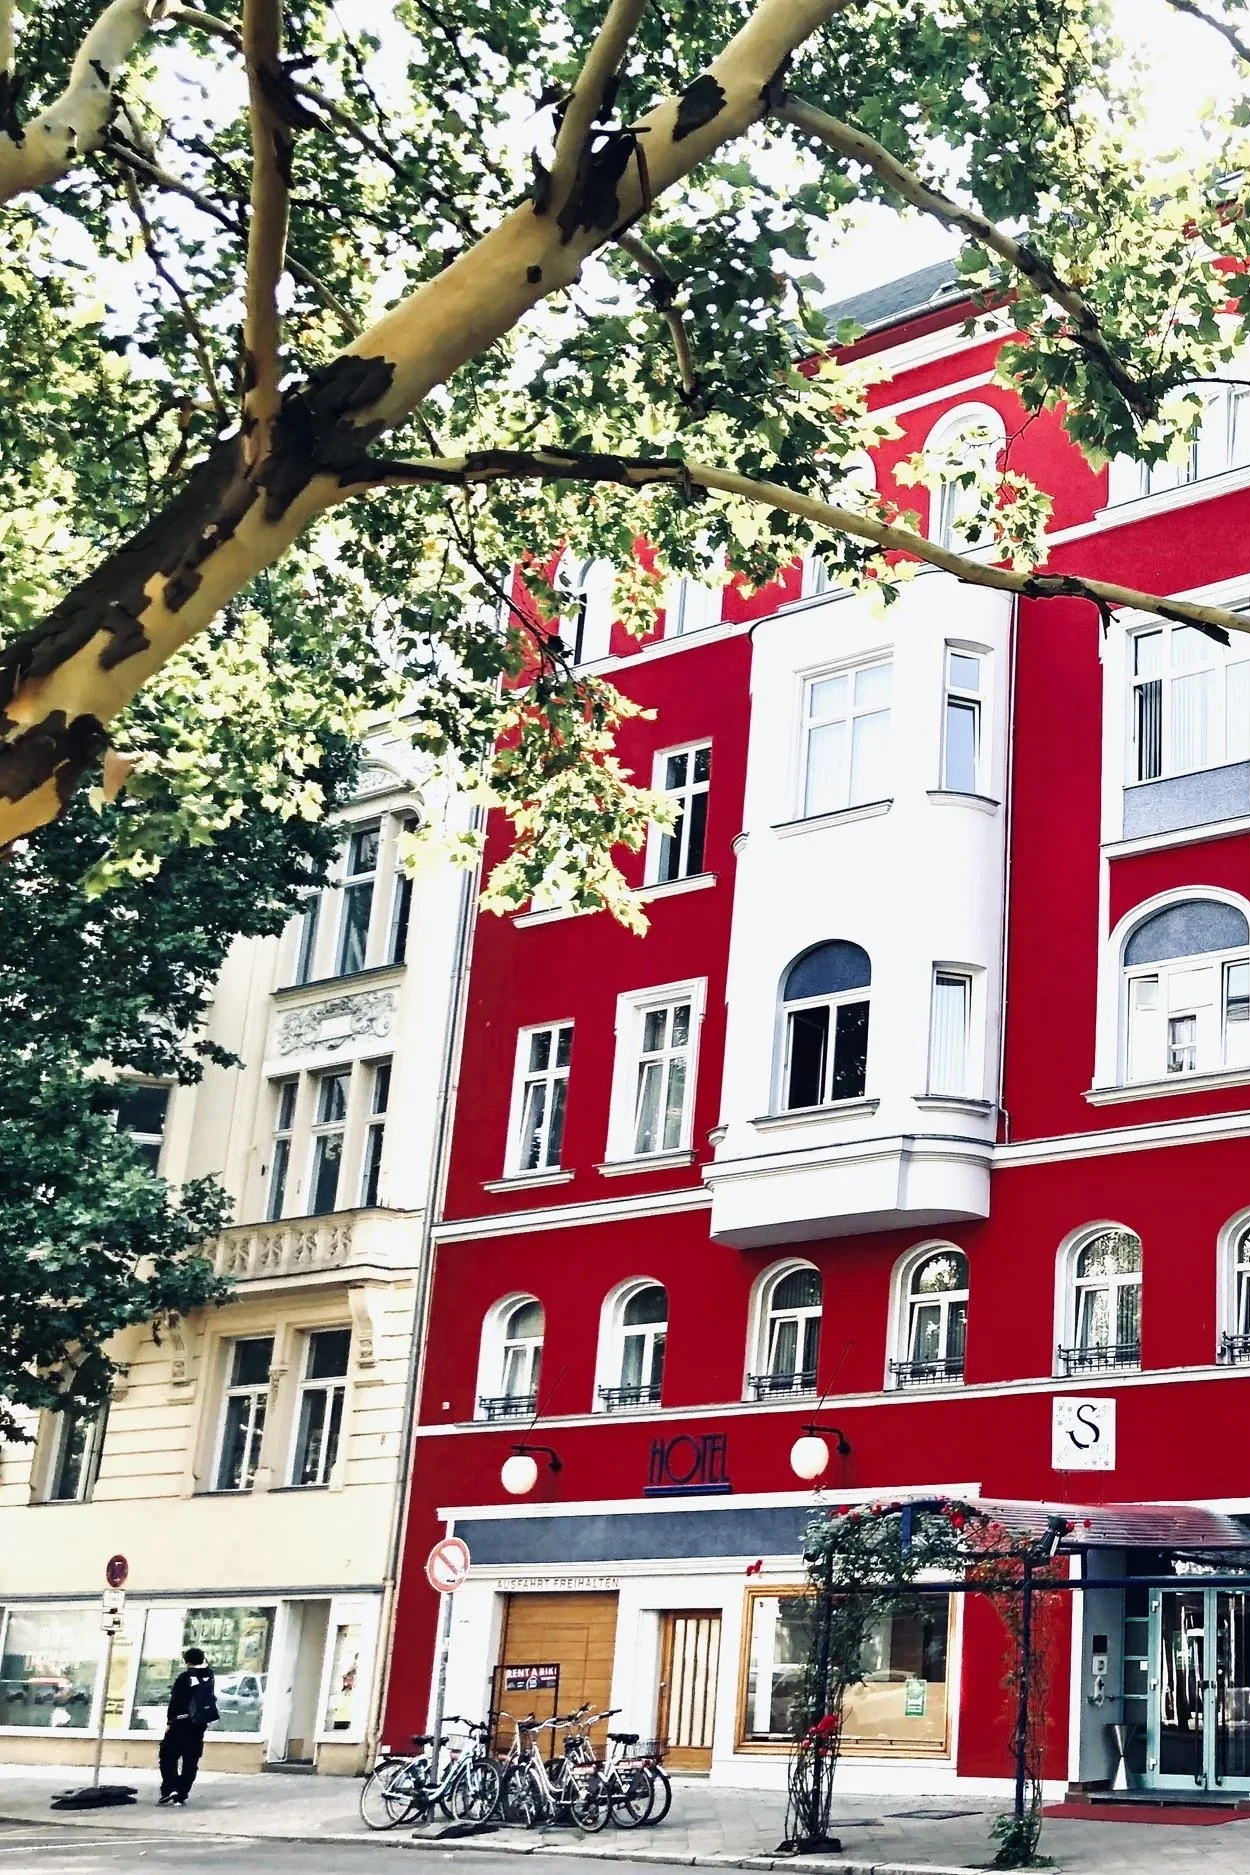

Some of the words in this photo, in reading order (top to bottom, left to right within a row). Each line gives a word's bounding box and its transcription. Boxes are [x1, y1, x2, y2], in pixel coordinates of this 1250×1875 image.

[1065, 1403, 1101, 1450] S
[648, 1432, 730, 1486] HOTEL
[496, 1579, 551, 1590] AUSFAHRT
[553, 1578, 620, 1589] FREIHALTEN
[506, 1668, 530, 1679] RENT
[531, 1667, 538, 1677] A
[539, 1666, 557, 1676] BIK
